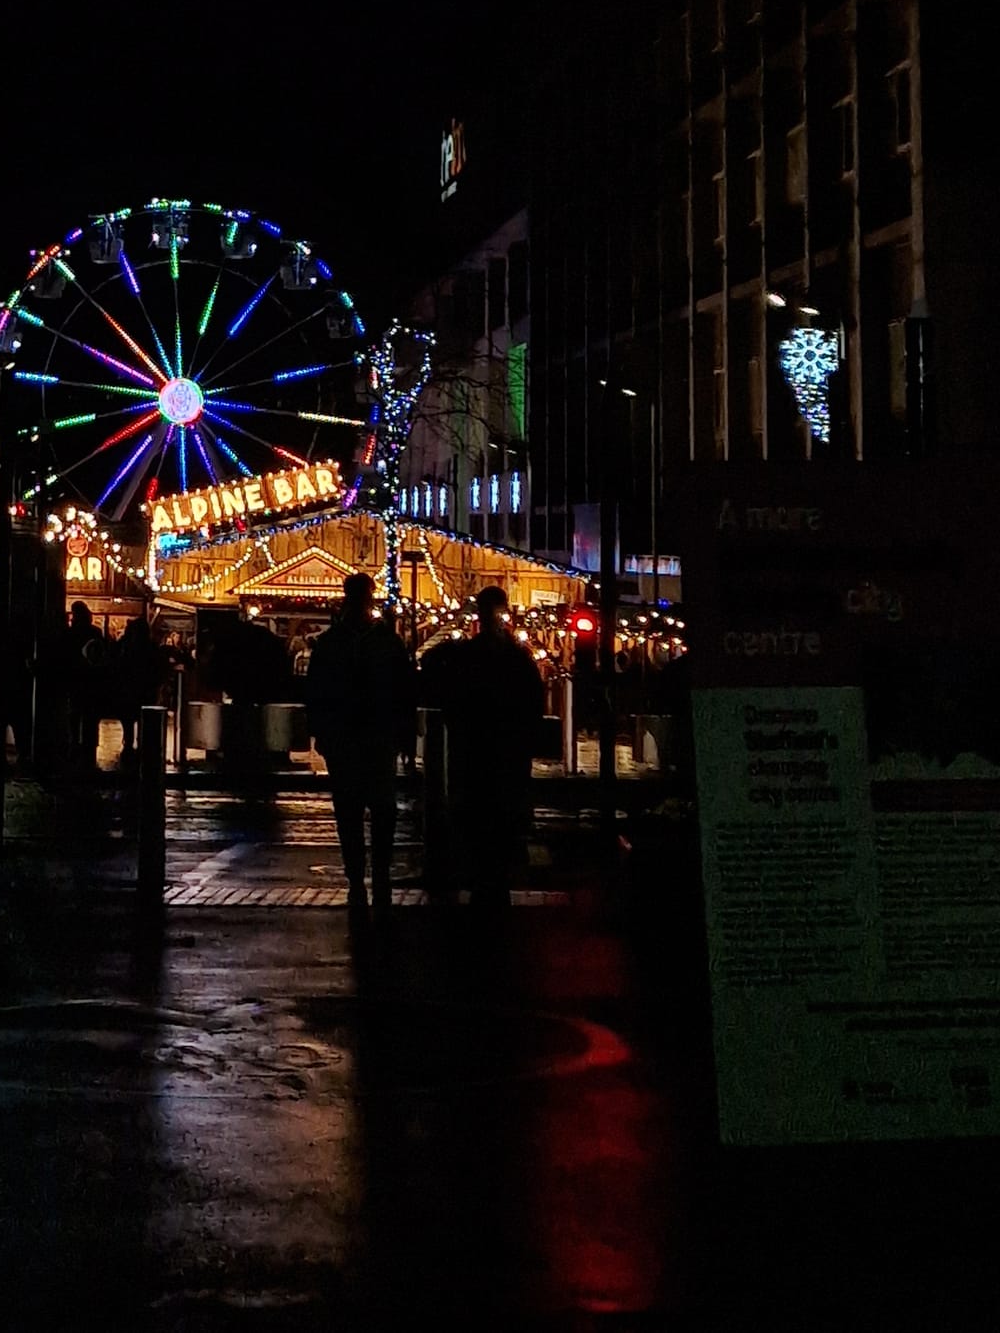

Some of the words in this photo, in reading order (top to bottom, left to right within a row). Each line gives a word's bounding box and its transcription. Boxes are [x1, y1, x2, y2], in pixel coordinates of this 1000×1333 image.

[151, 483, 266, 532] ALPINE
[273, 468, 338, 504] BAR
[716, 498, 738, 530] A
[746, 506, 824, 532] more
[66, 557, 104, 580] AR
[723, 624, 823, 657] centre
